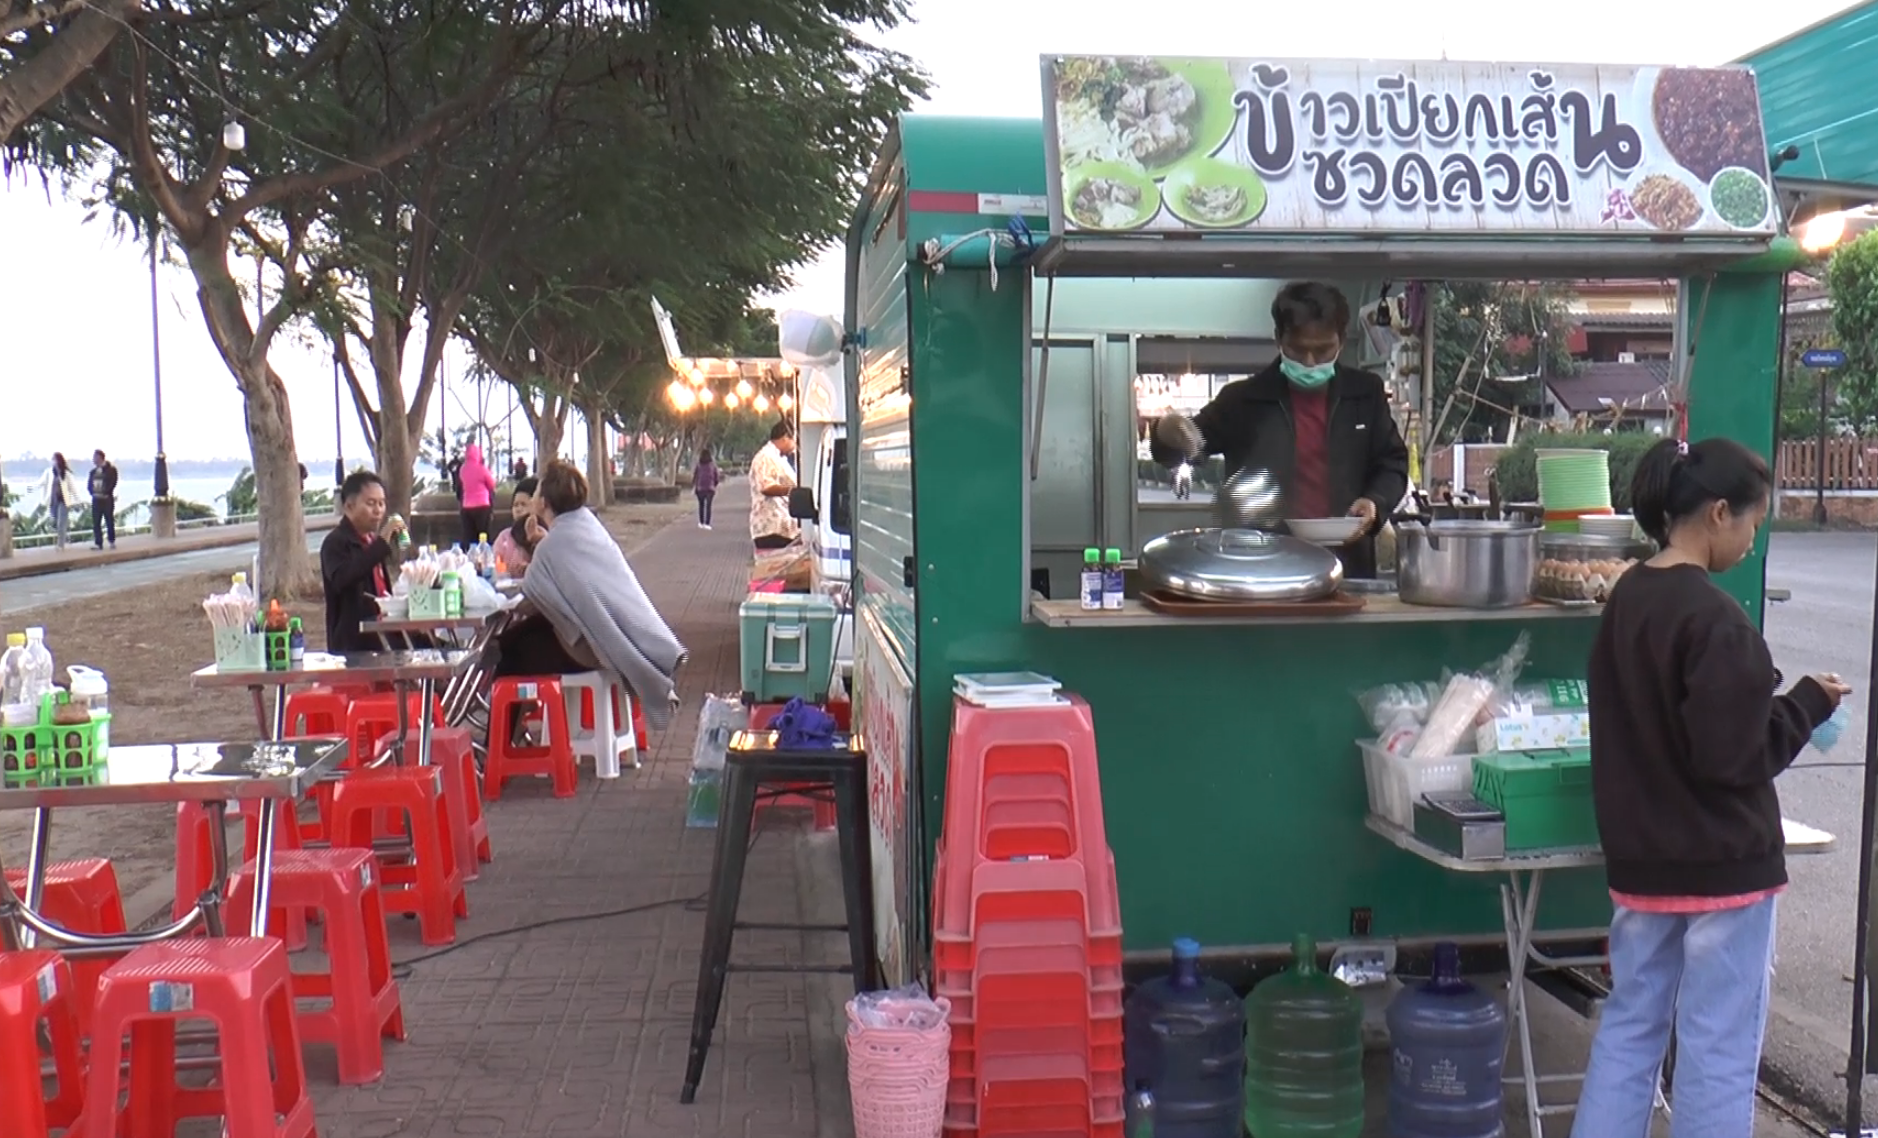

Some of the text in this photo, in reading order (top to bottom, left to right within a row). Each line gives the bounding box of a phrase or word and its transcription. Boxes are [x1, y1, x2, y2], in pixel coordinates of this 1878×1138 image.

[1233, 63, 1643, 172] ข้าวเปียกเส้น
